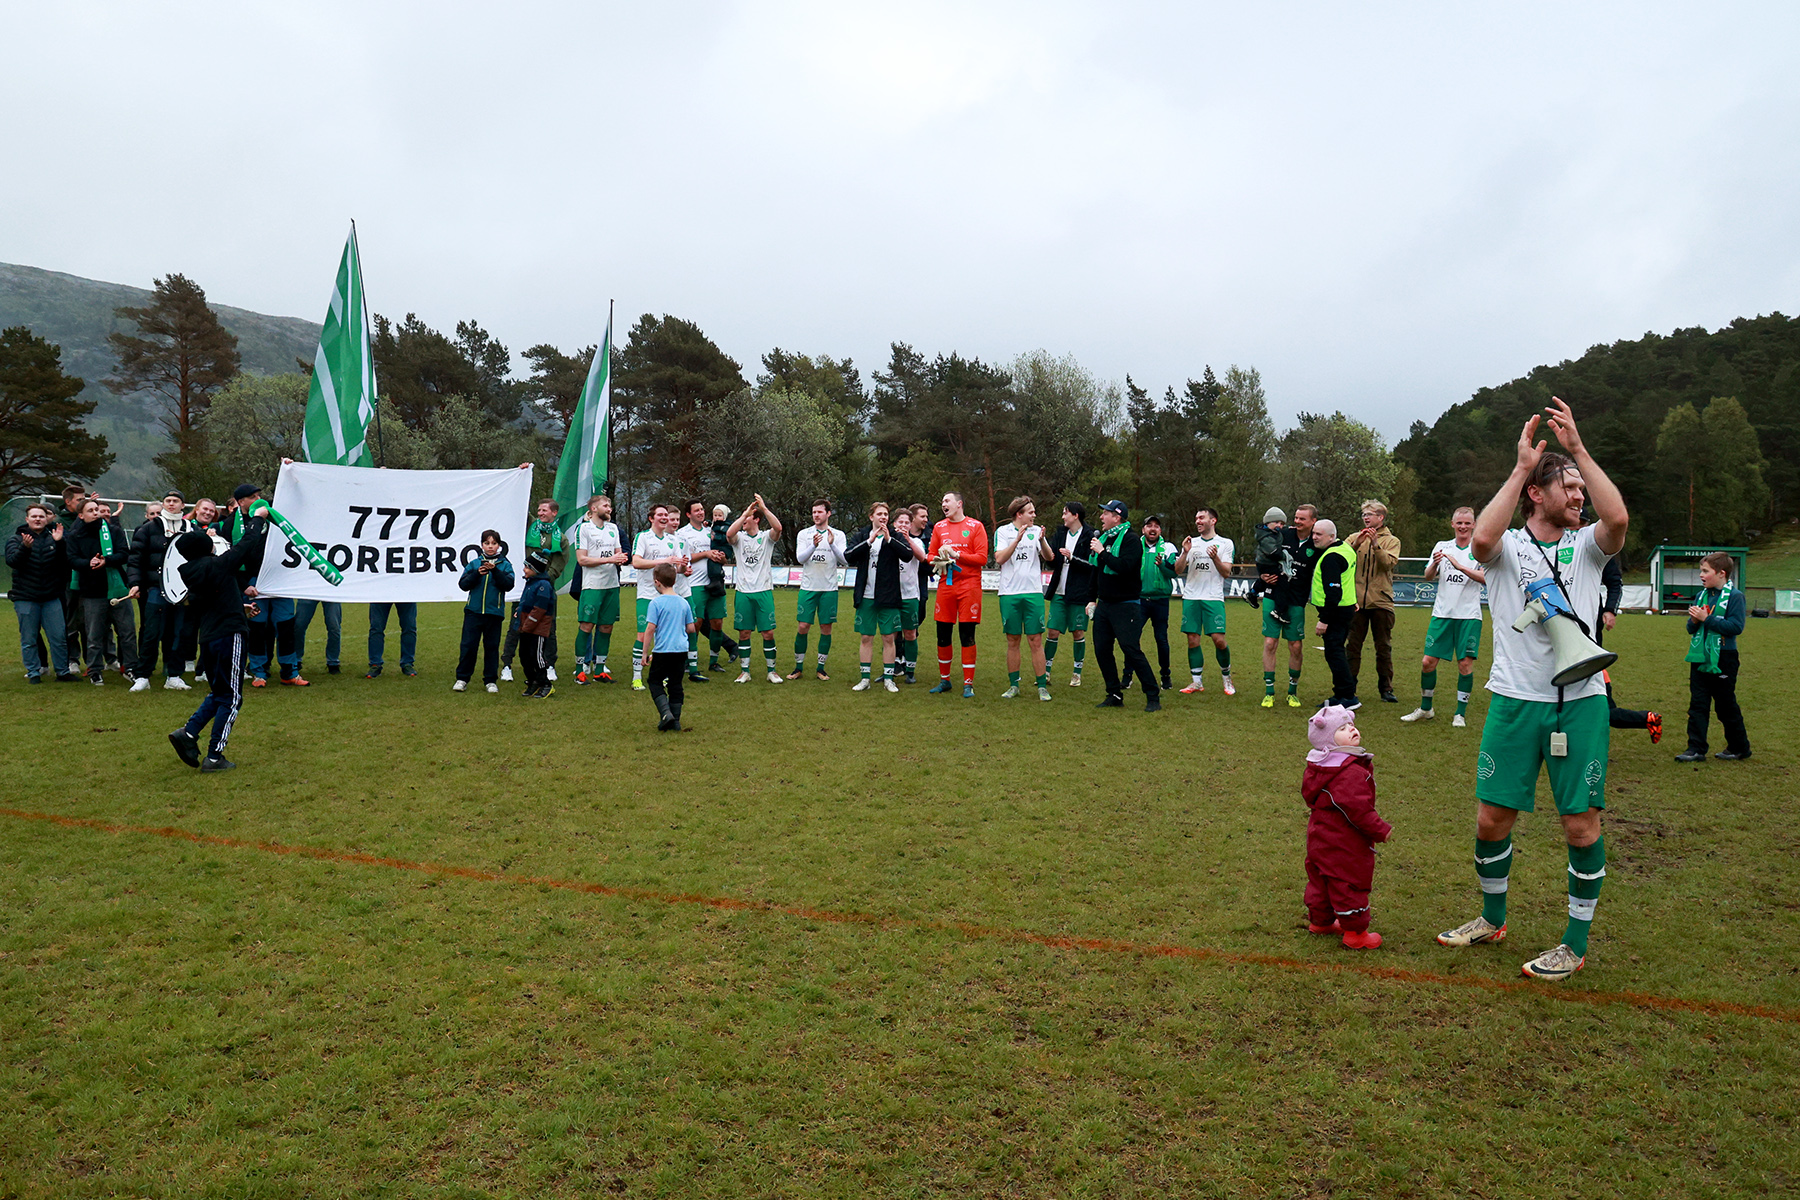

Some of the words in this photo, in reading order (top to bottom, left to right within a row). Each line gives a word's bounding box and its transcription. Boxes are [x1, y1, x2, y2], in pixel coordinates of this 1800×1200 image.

[349, 506, 455, 540] 7770
[1195, 562, 1210, 570] AQS
[1446, 574, 1464, 583] AQS
